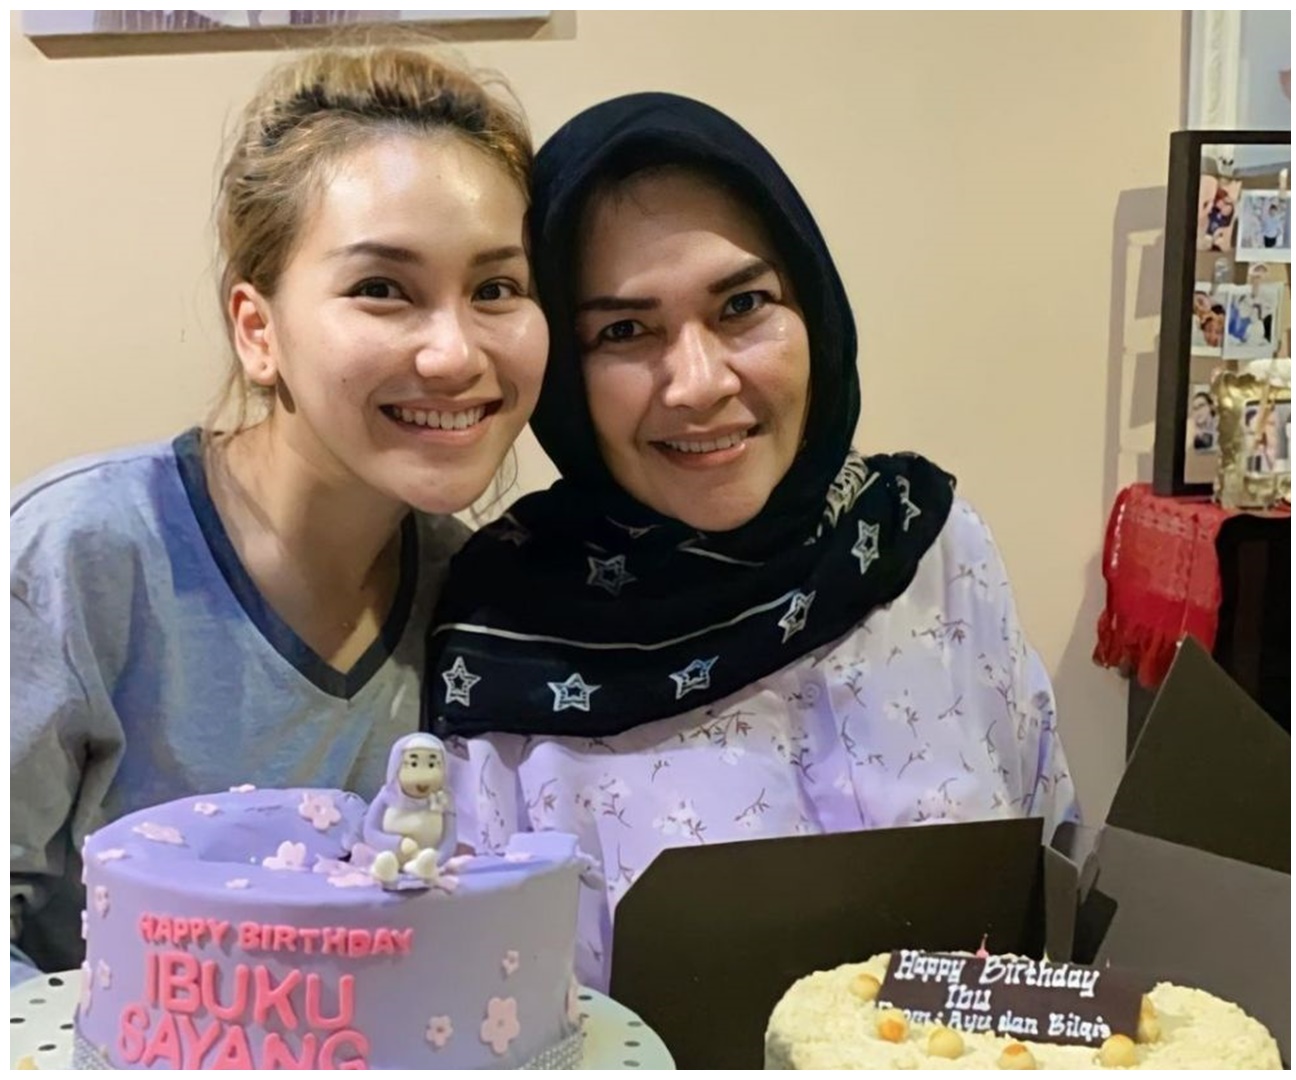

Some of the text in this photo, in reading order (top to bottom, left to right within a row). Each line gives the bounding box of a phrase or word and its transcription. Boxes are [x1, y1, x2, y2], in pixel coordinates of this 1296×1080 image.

[138, 913, 413, 957] HAPPY BIRTHDAY
[145, 953, 355, 1031] IBUKU
[893, 949, 1100, 998] Happy Birthday
[117, 1005, 372, 1069] SAYANG
[947, 1010, 993, 1033] Ayu
[998, 1011, 1038, 1035] dan
[1048, 1012, 1111, 1042] Bilqis
